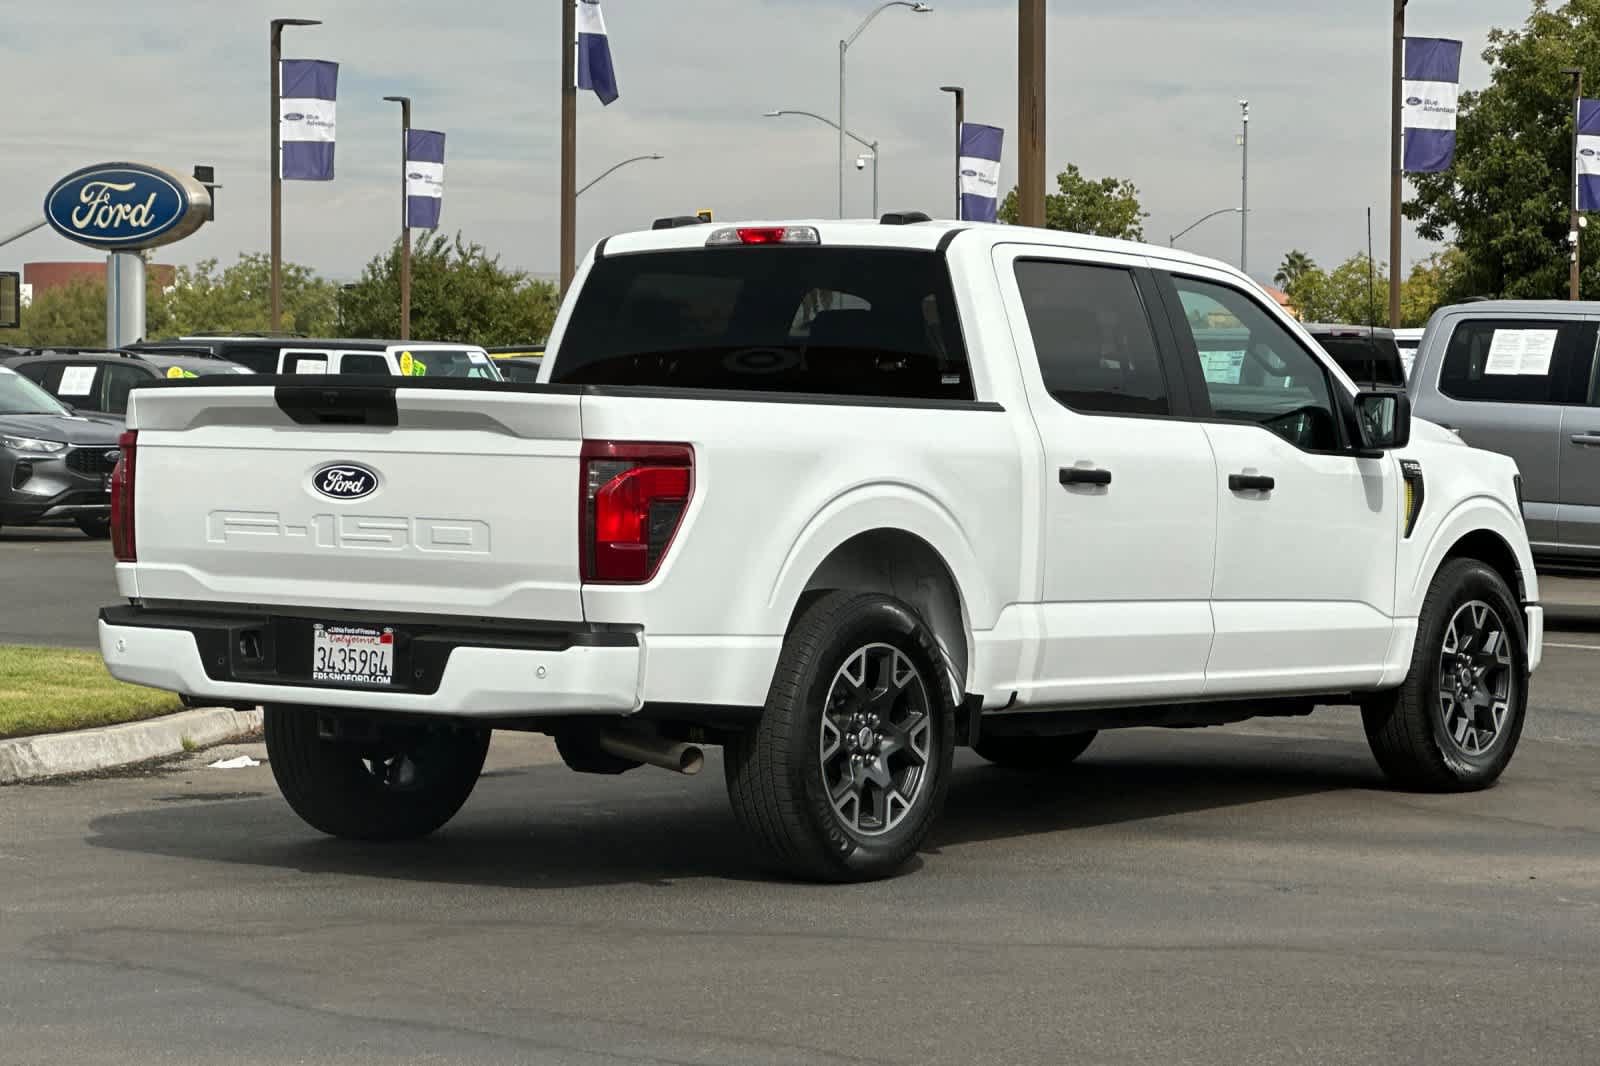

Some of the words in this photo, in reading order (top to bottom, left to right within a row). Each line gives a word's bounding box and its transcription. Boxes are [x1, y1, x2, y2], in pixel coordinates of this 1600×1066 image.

[71, 181, 157, 229] Ford
[323, 469, 365, 494] Ford
[207, 510, 491, 554] F-150
[329, 634, 375, 646] California
[317, 646, 388, 675] 34359G4
